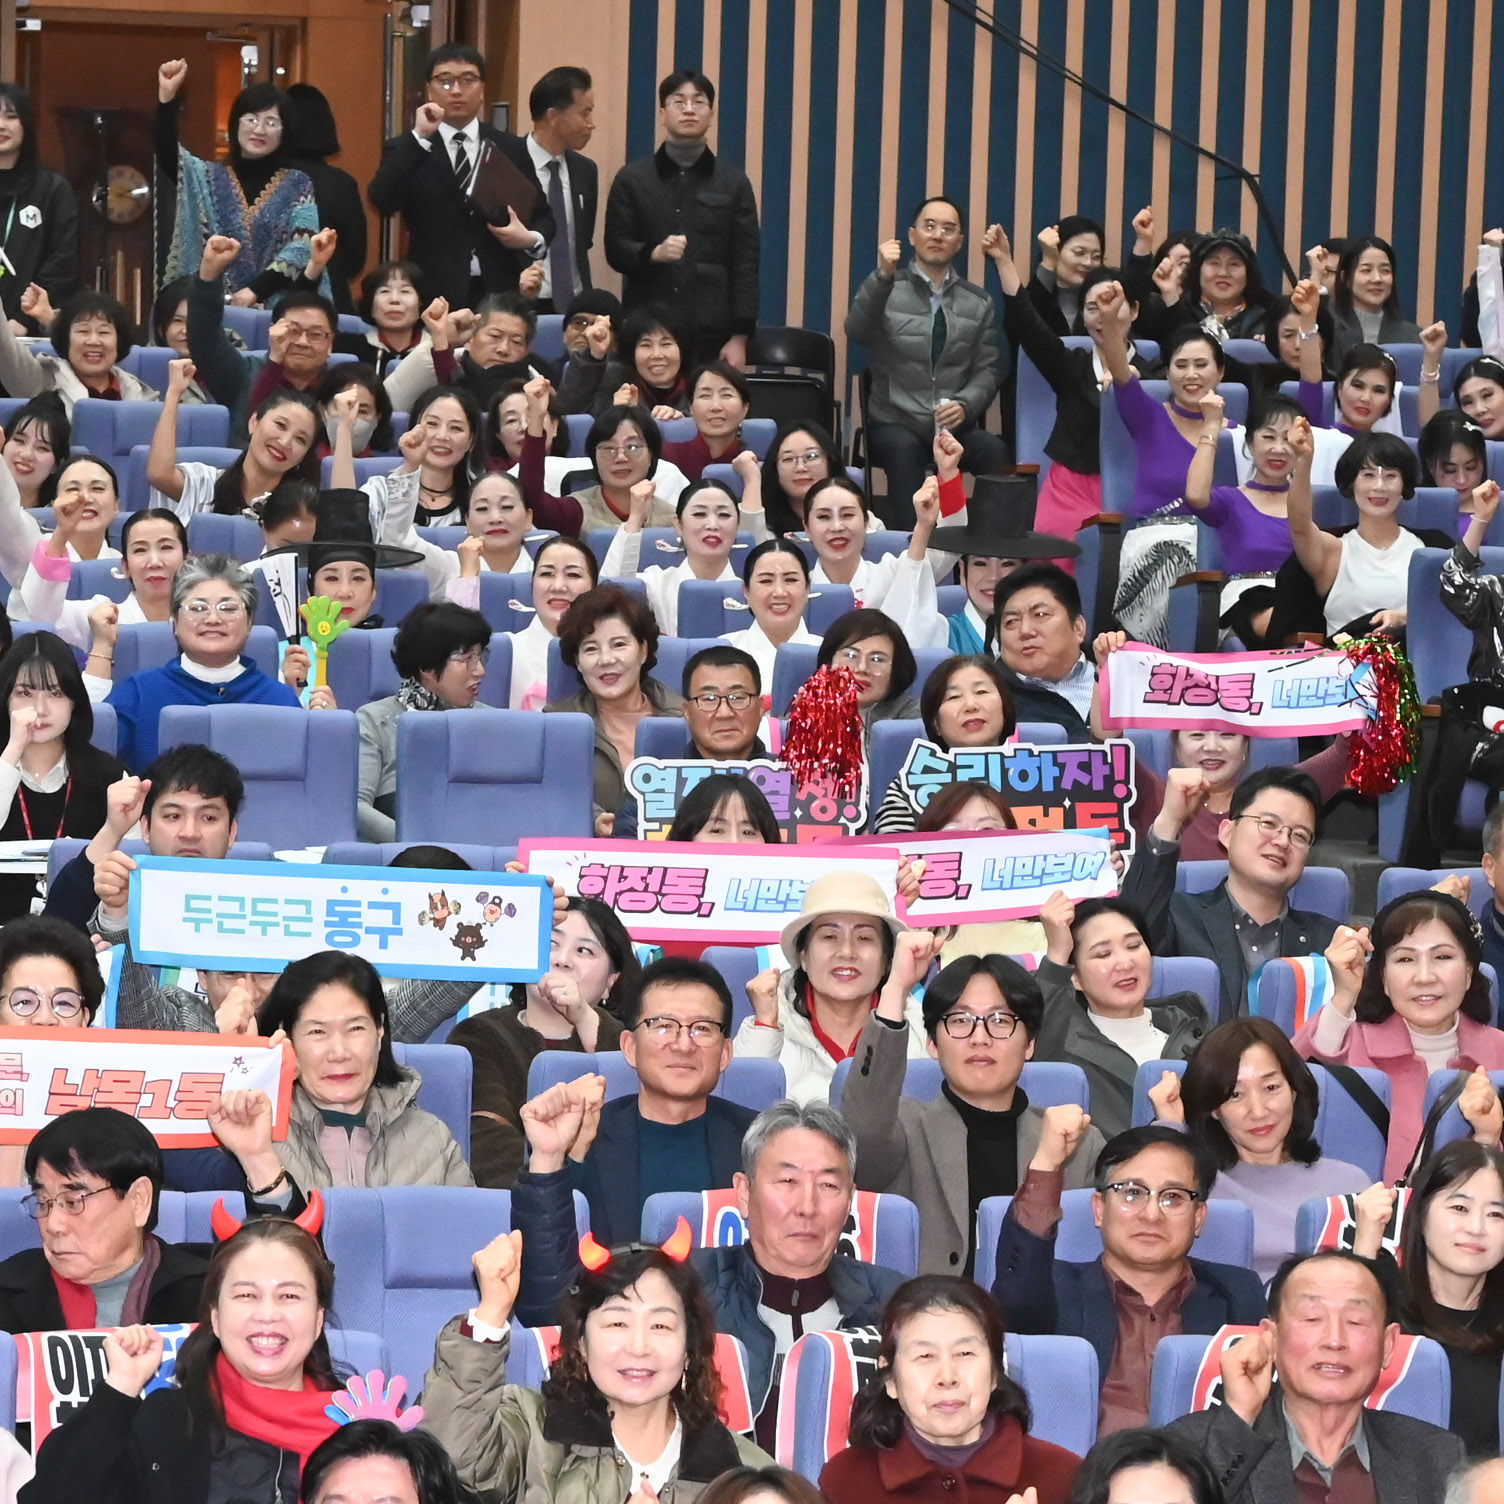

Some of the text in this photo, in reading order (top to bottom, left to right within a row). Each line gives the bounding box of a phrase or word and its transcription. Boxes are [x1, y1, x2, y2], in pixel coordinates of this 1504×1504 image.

[1143, 663, 1263, 715] 화정동,
[907, 745, 1129, 806] 승리하자!
[981, 851, 1106, 891] 너만보여
[182, 893, 404, 950] 두근두근 동구
[44, 1068, 227, 1120] 남목1동
